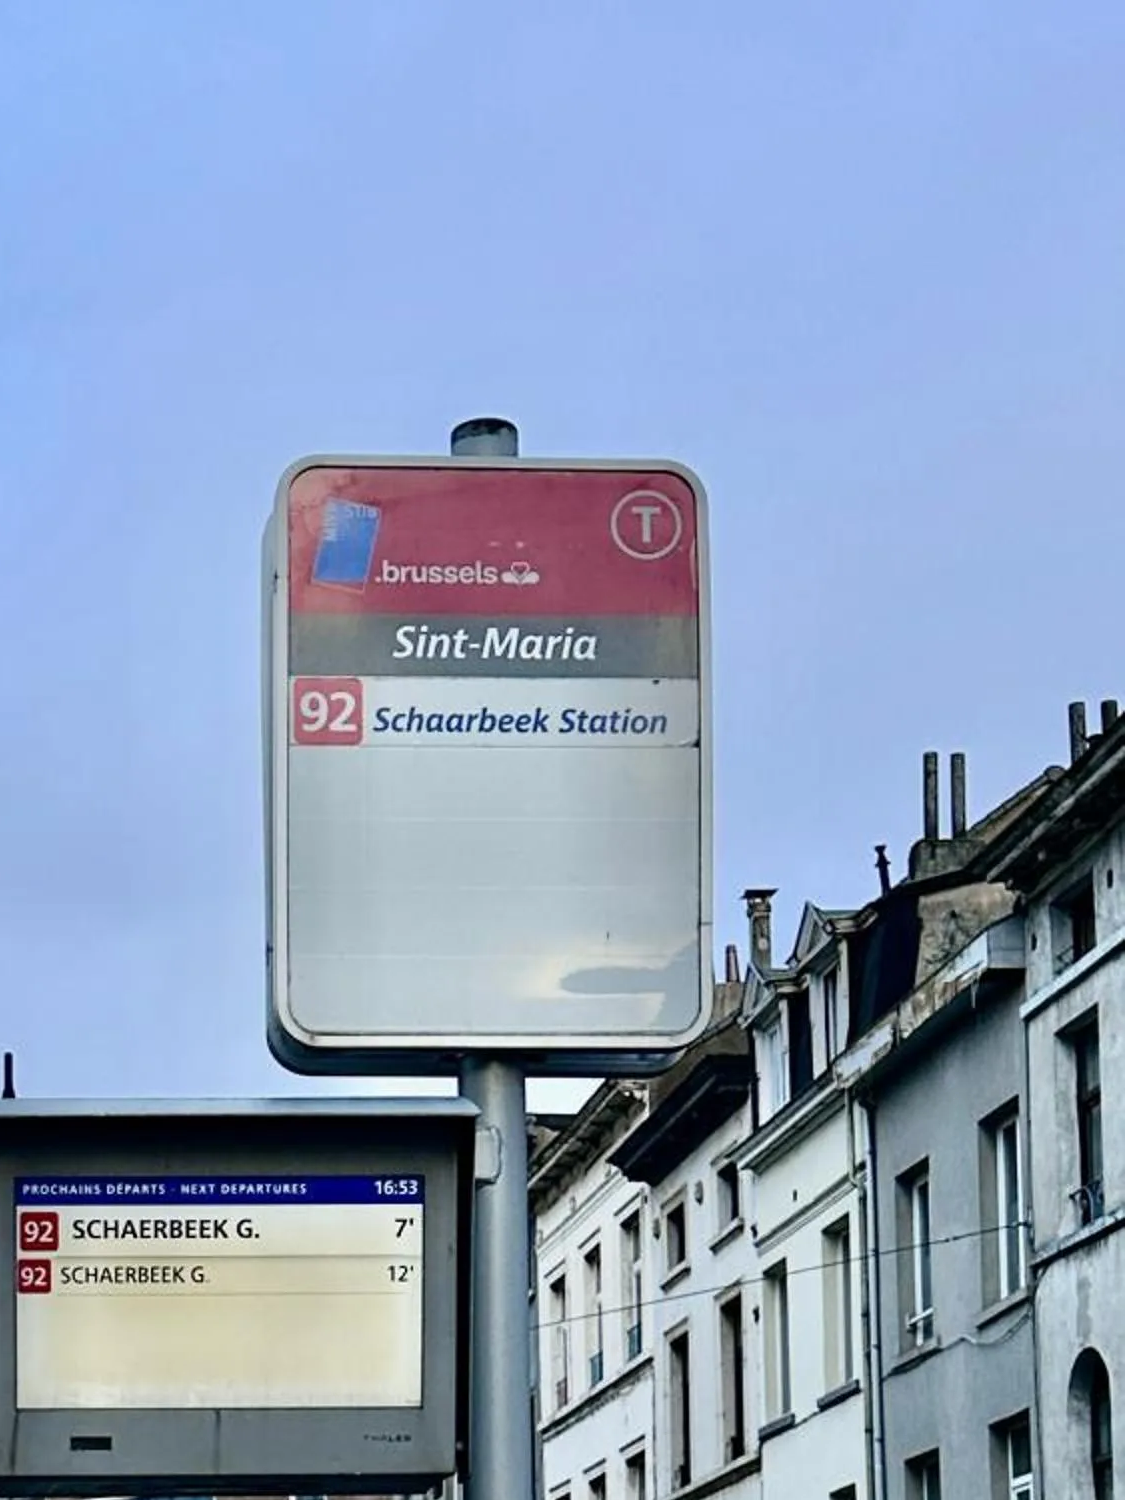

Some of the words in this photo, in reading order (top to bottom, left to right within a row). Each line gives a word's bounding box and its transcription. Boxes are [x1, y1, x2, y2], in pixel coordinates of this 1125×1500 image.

[631, 505, 661, 543] T
[392, 625, 597, 661] Sint-Maria
[299, 691, 359, 733] 92
[373, 707, 550, 734] Schaarbeek
[558, 708, 668, 735] Station
[22, 1183, 102, 1195] PROCHAINS
[106, 1182, 166, 1195] DÉPARTS
[180, 1183, 216, 1195] NEXT
[220, 1183, 307, 1194] DEPARTURES
[374, 1180, 419, 1195] 16:53
[24, 1221, 55, 1243] 92
[72, 1220, 229, 1239] SCHAERBEEK
[236, 1218, 260, 1239] G.
[20, 1266, 47, 1287] 92
[60, 1266, 185, 1284] SCHAERBEEK
